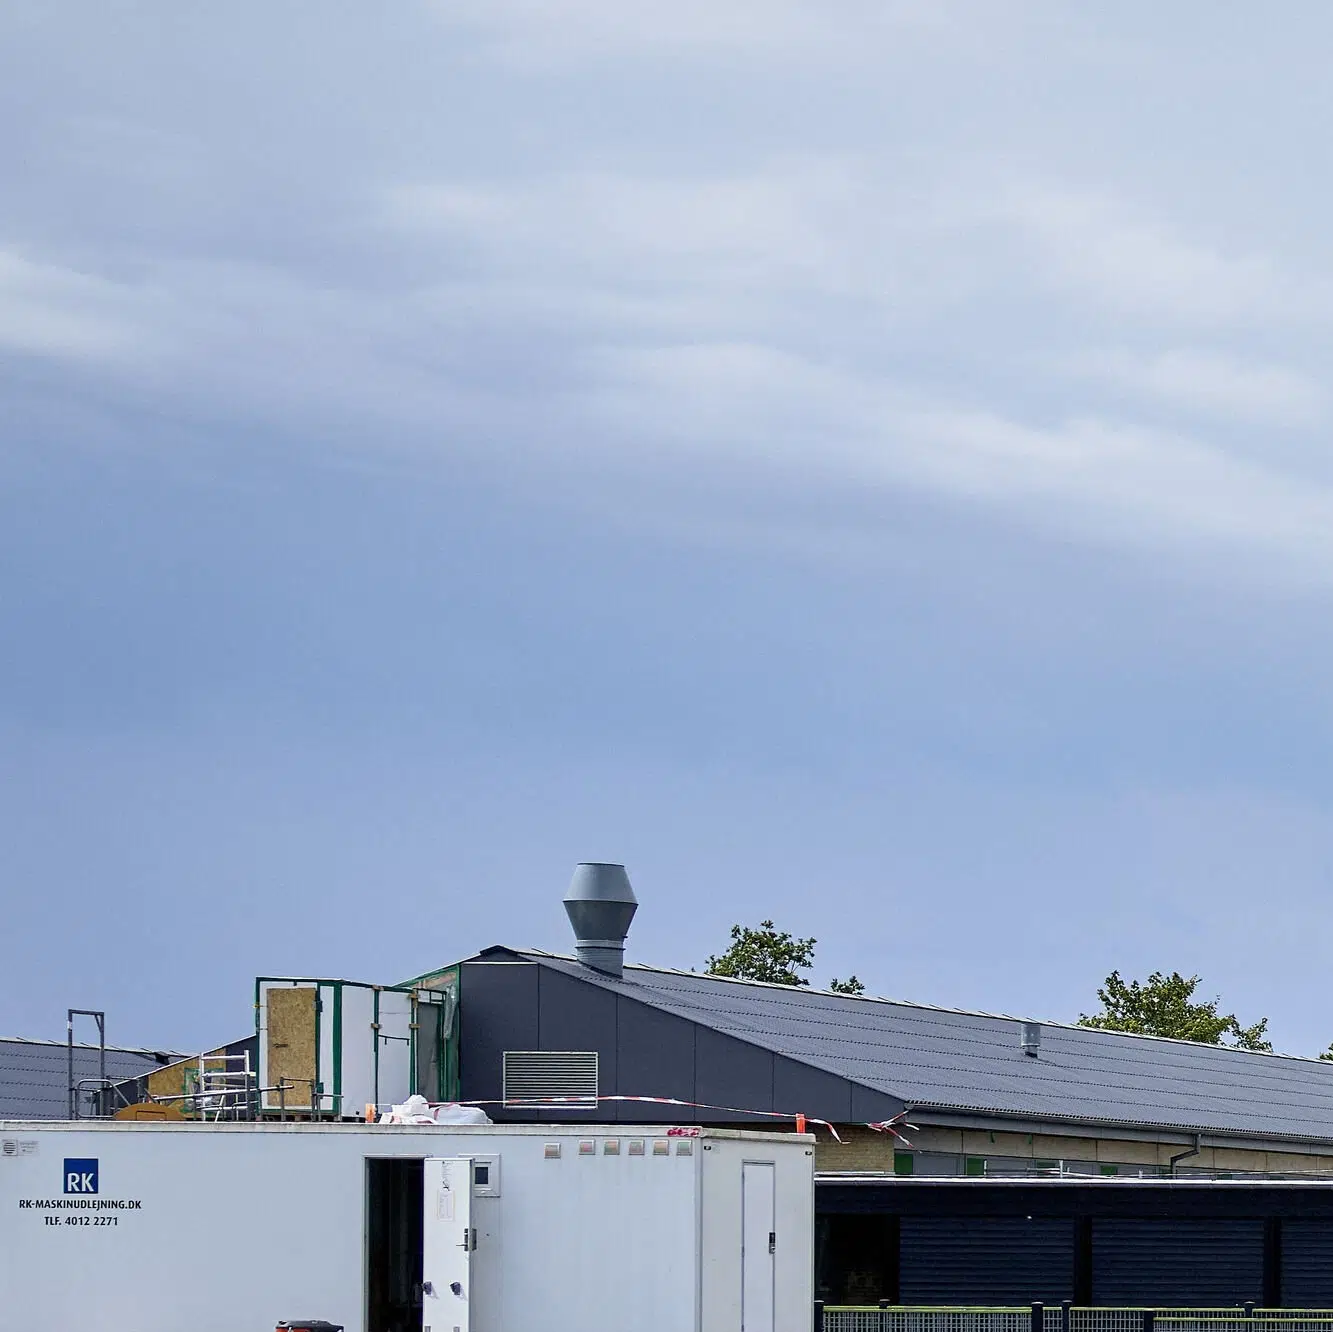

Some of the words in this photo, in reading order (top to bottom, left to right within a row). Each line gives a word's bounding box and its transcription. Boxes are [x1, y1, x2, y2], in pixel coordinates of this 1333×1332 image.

[67, 1172, 95, 1192] RK
[19, 1199, 142, 1211] RK-MASKINUDLEJNING.DK
[44, 1216, 62, 1226] TLF.
[65, 1216, 90, 1226] 4012
[93, 1216, 118, 1226] 2271
